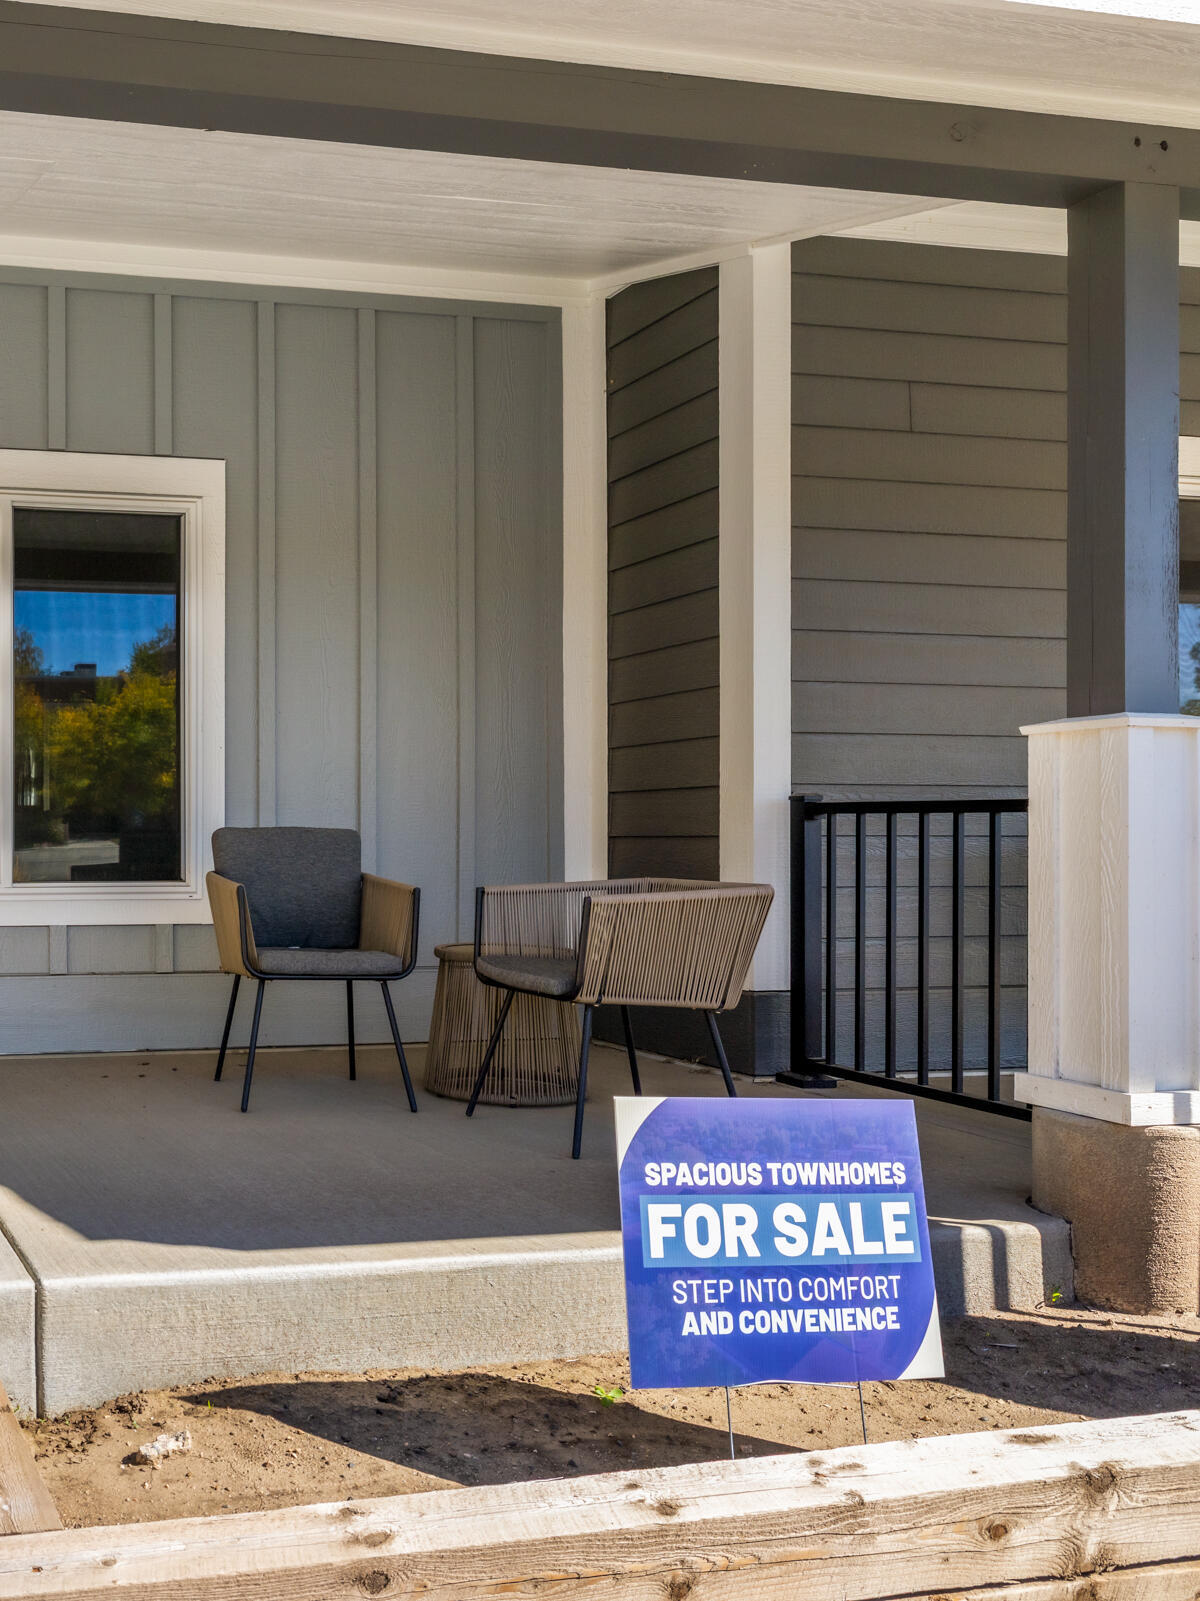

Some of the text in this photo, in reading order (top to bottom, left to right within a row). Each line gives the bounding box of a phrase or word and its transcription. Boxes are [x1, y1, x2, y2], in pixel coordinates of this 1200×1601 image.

[644, 1161, 907, 1187] SPACIOUS TOWNHOMES
[647, 1201, 915, 1259] FOR SALE
[672, 1275, 902, 1305] STEP INTO COMFORT
[681, 1306, 901, 1336] AND CONVENIENCE
